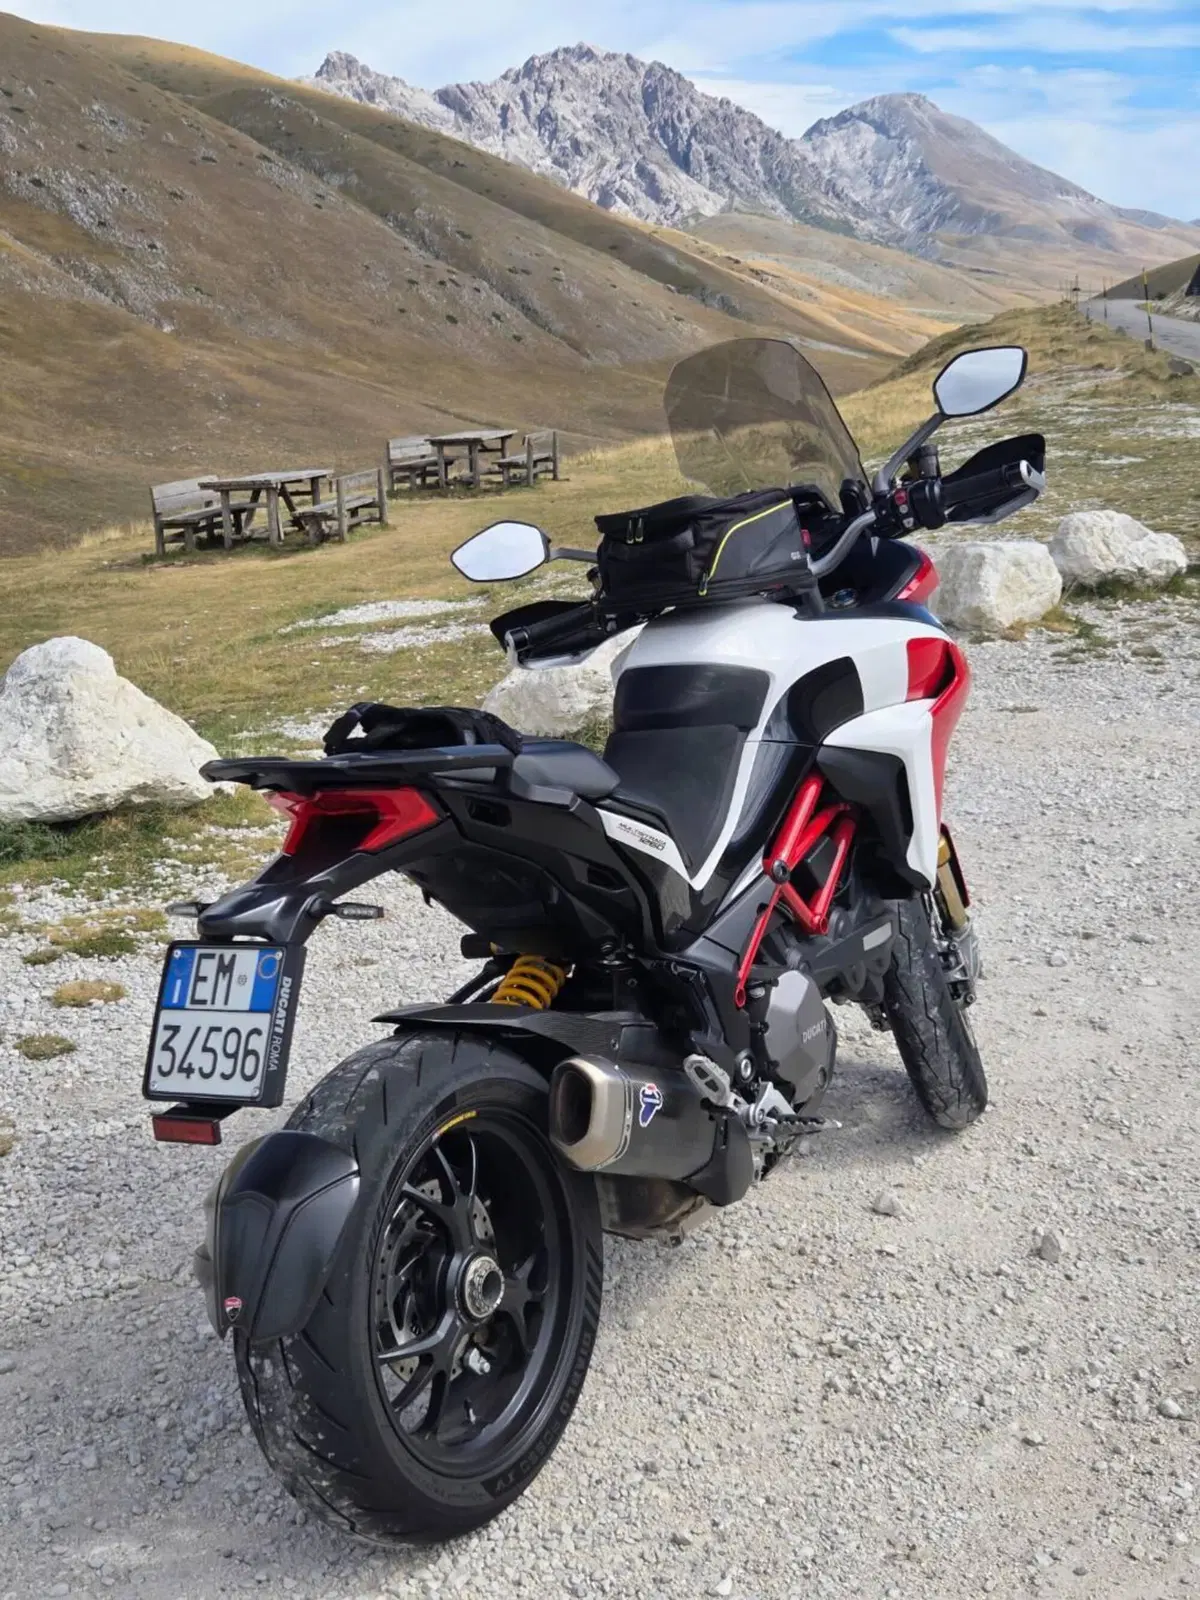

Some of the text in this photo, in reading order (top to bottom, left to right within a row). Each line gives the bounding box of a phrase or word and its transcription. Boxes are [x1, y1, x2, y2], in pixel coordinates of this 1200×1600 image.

[189, 953, 237, 1006] EM
[268, 976, 292, 1071] DUCATI ROMA
[802, 1018, 827, 1044] DUCATI
[157, 1024, 263, 1082] 34596
